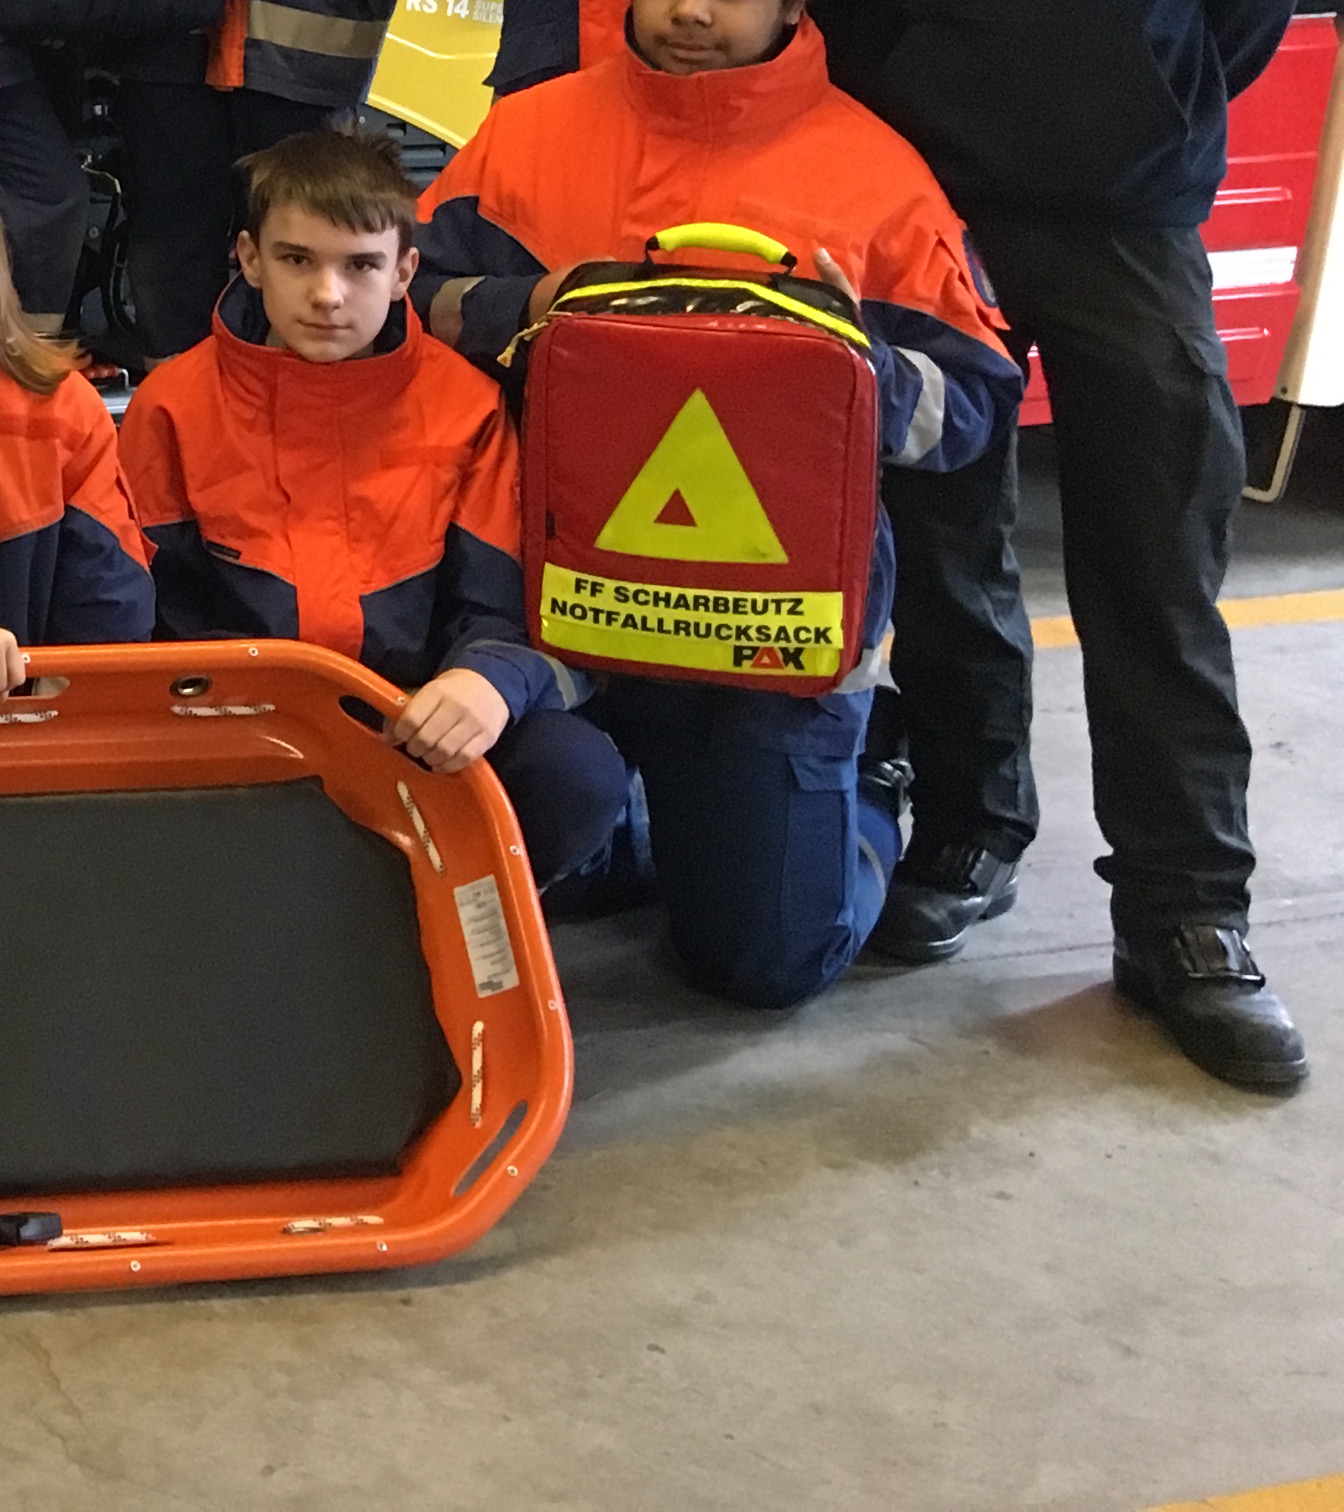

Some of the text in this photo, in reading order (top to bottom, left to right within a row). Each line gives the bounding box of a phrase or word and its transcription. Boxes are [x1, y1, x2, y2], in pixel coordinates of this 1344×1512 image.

[574, 577, 805, 617] FF SCHARBEUTZ
[550, 597, 832, 645] NOTFALLRUCKSACK
[733, 645, 805, 671] PAX
